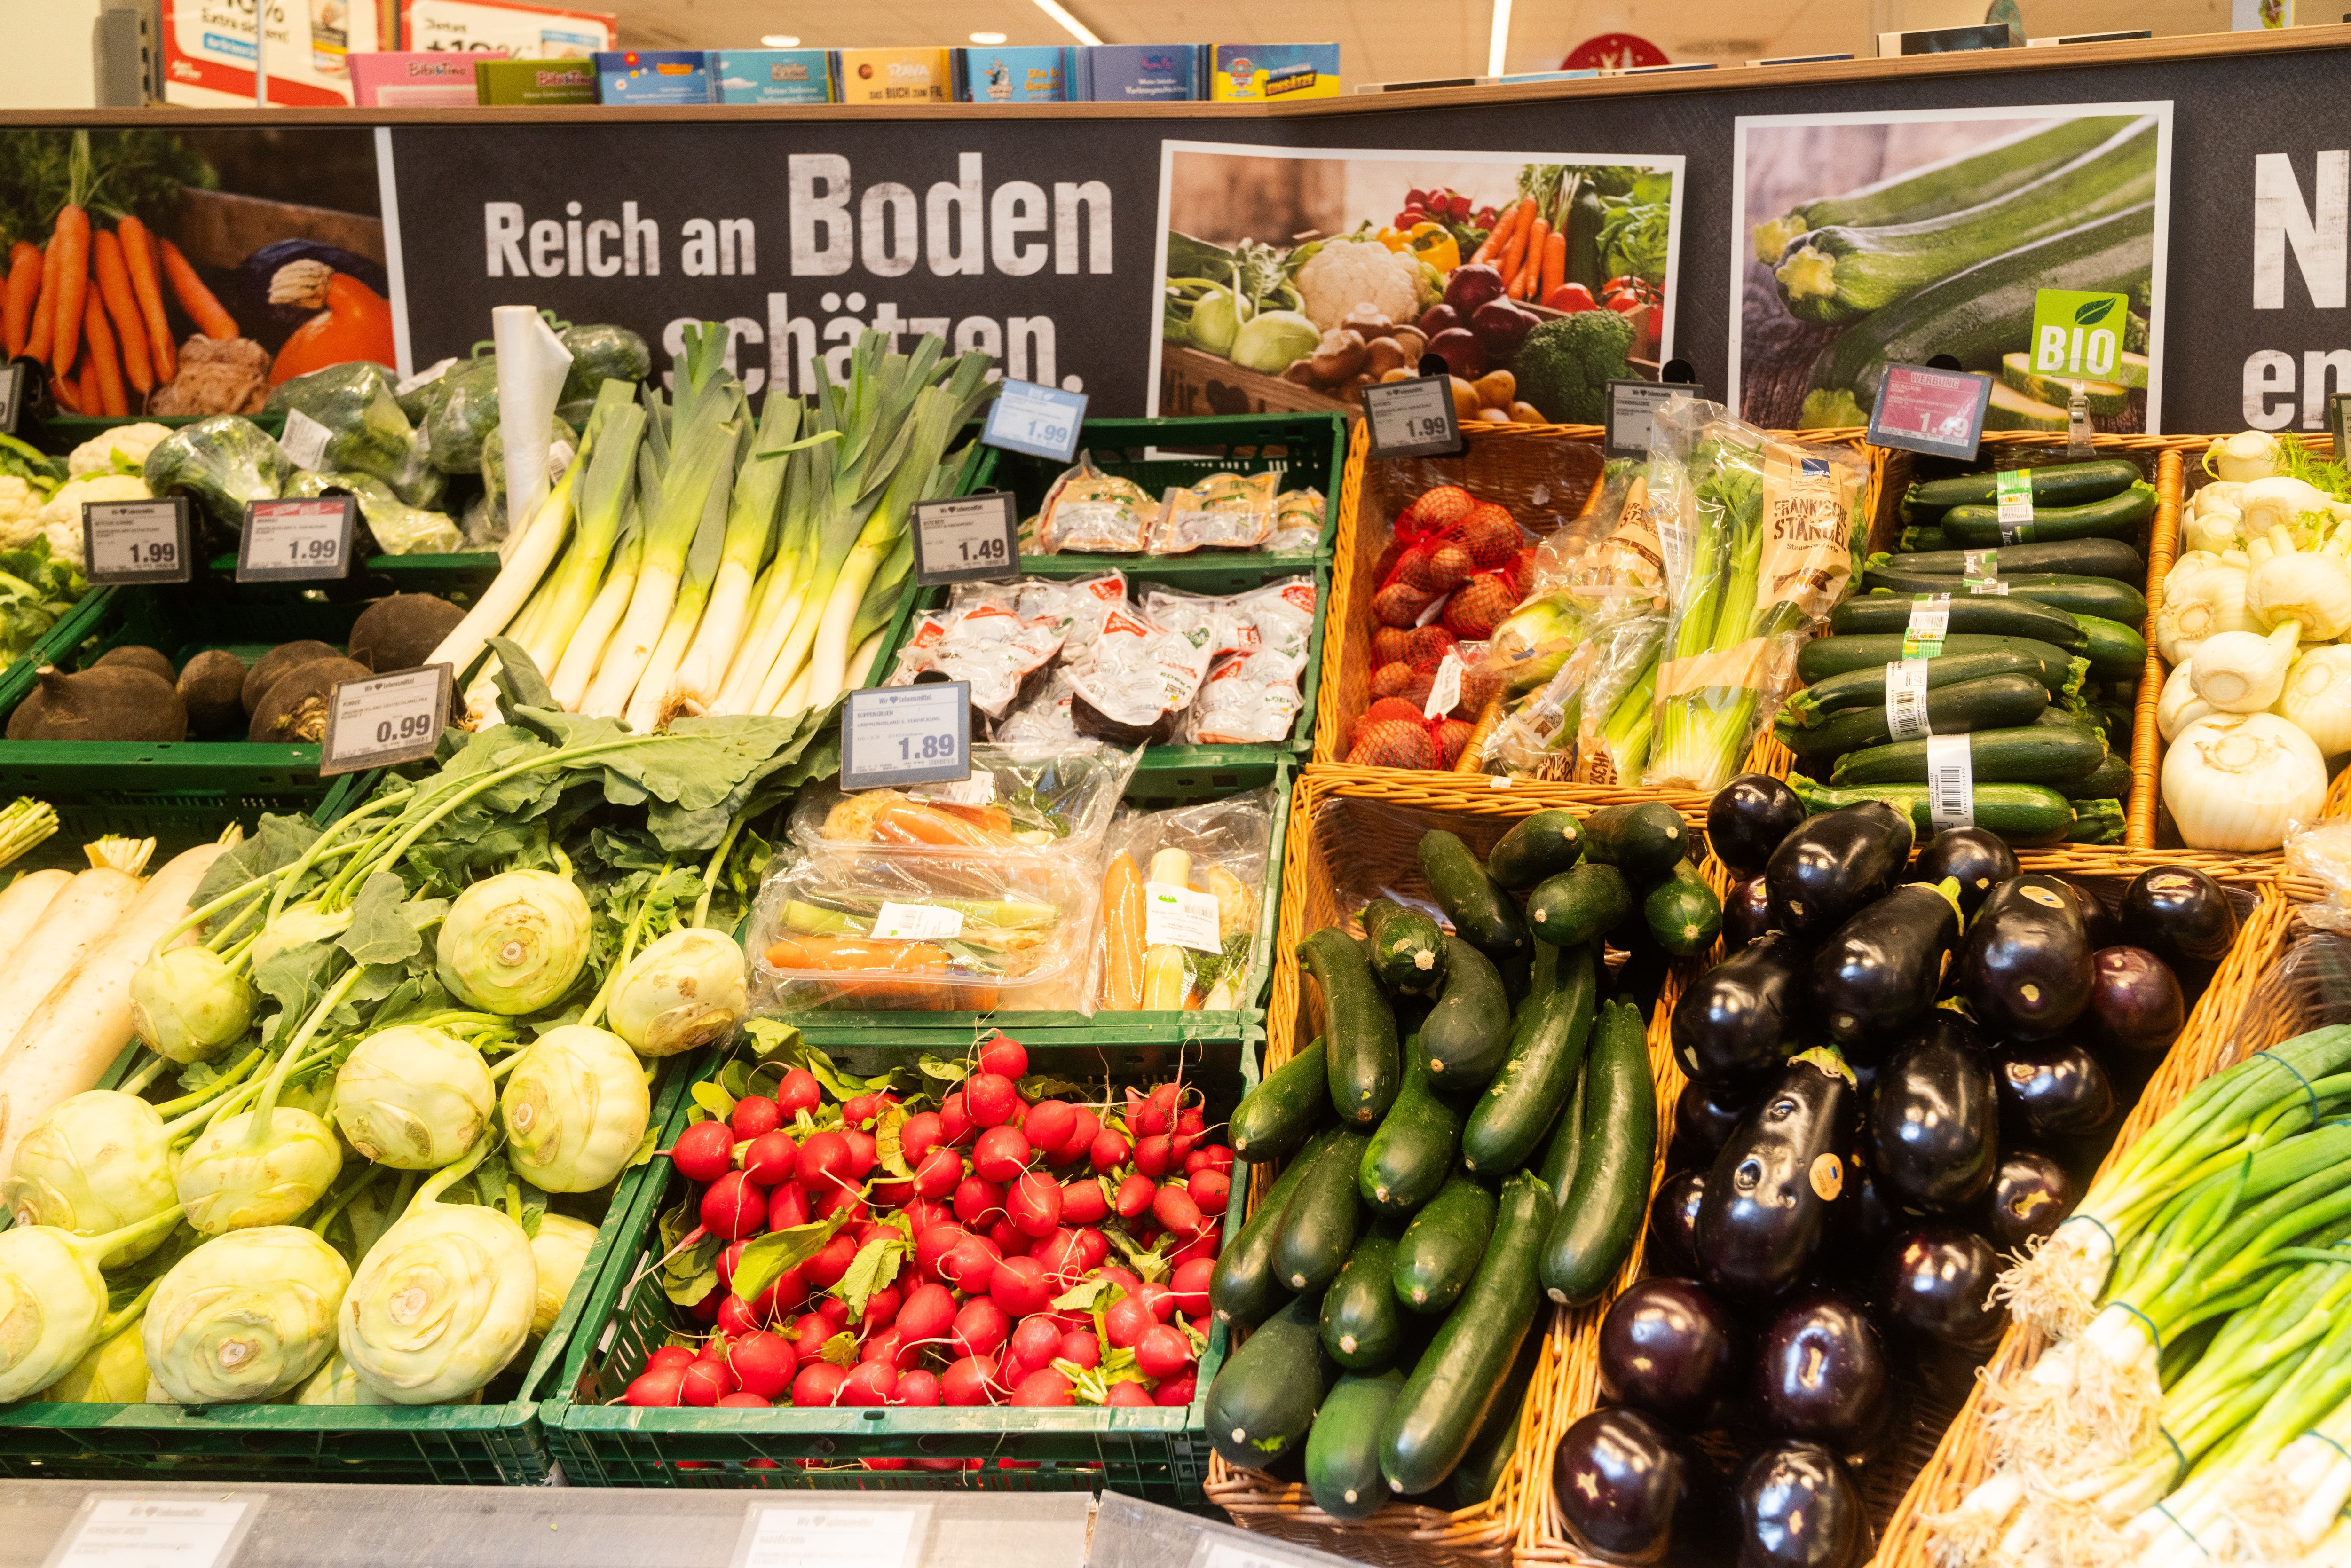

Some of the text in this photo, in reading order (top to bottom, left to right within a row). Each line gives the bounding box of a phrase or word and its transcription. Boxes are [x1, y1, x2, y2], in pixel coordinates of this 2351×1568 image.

[484, 152, 1113, 278] Reich an Boden
[2036, 325, 2116, 376] BIO
[1911, 372, 1960, 390] WERBUNG
[1028, 421, 1068, 443] 1.99
[1405, 417, 1447, 438] 1.99
[1920, 412, 1969, 438] 1.49
[1774, 496, 1848, 528] FRÄNKISCHE
[1774, 514, 1846, 552] STÄNGEL
[129, 543, 175, 563] 1.99
[289, 539, 337, 559] 1.99
[958, 538, 1005, 561] 1.49
[383, 678, 414, 689] Lebensmittel
[1160, 671, 1192, 691] EDEKA
[899, 694, 932, 703] Lebensmittel
[377, 713, 431, 743] 0.99
[898, 734, 955, 760] 1.89
[759, 1536, 806, 1545] RADIESCHEN
